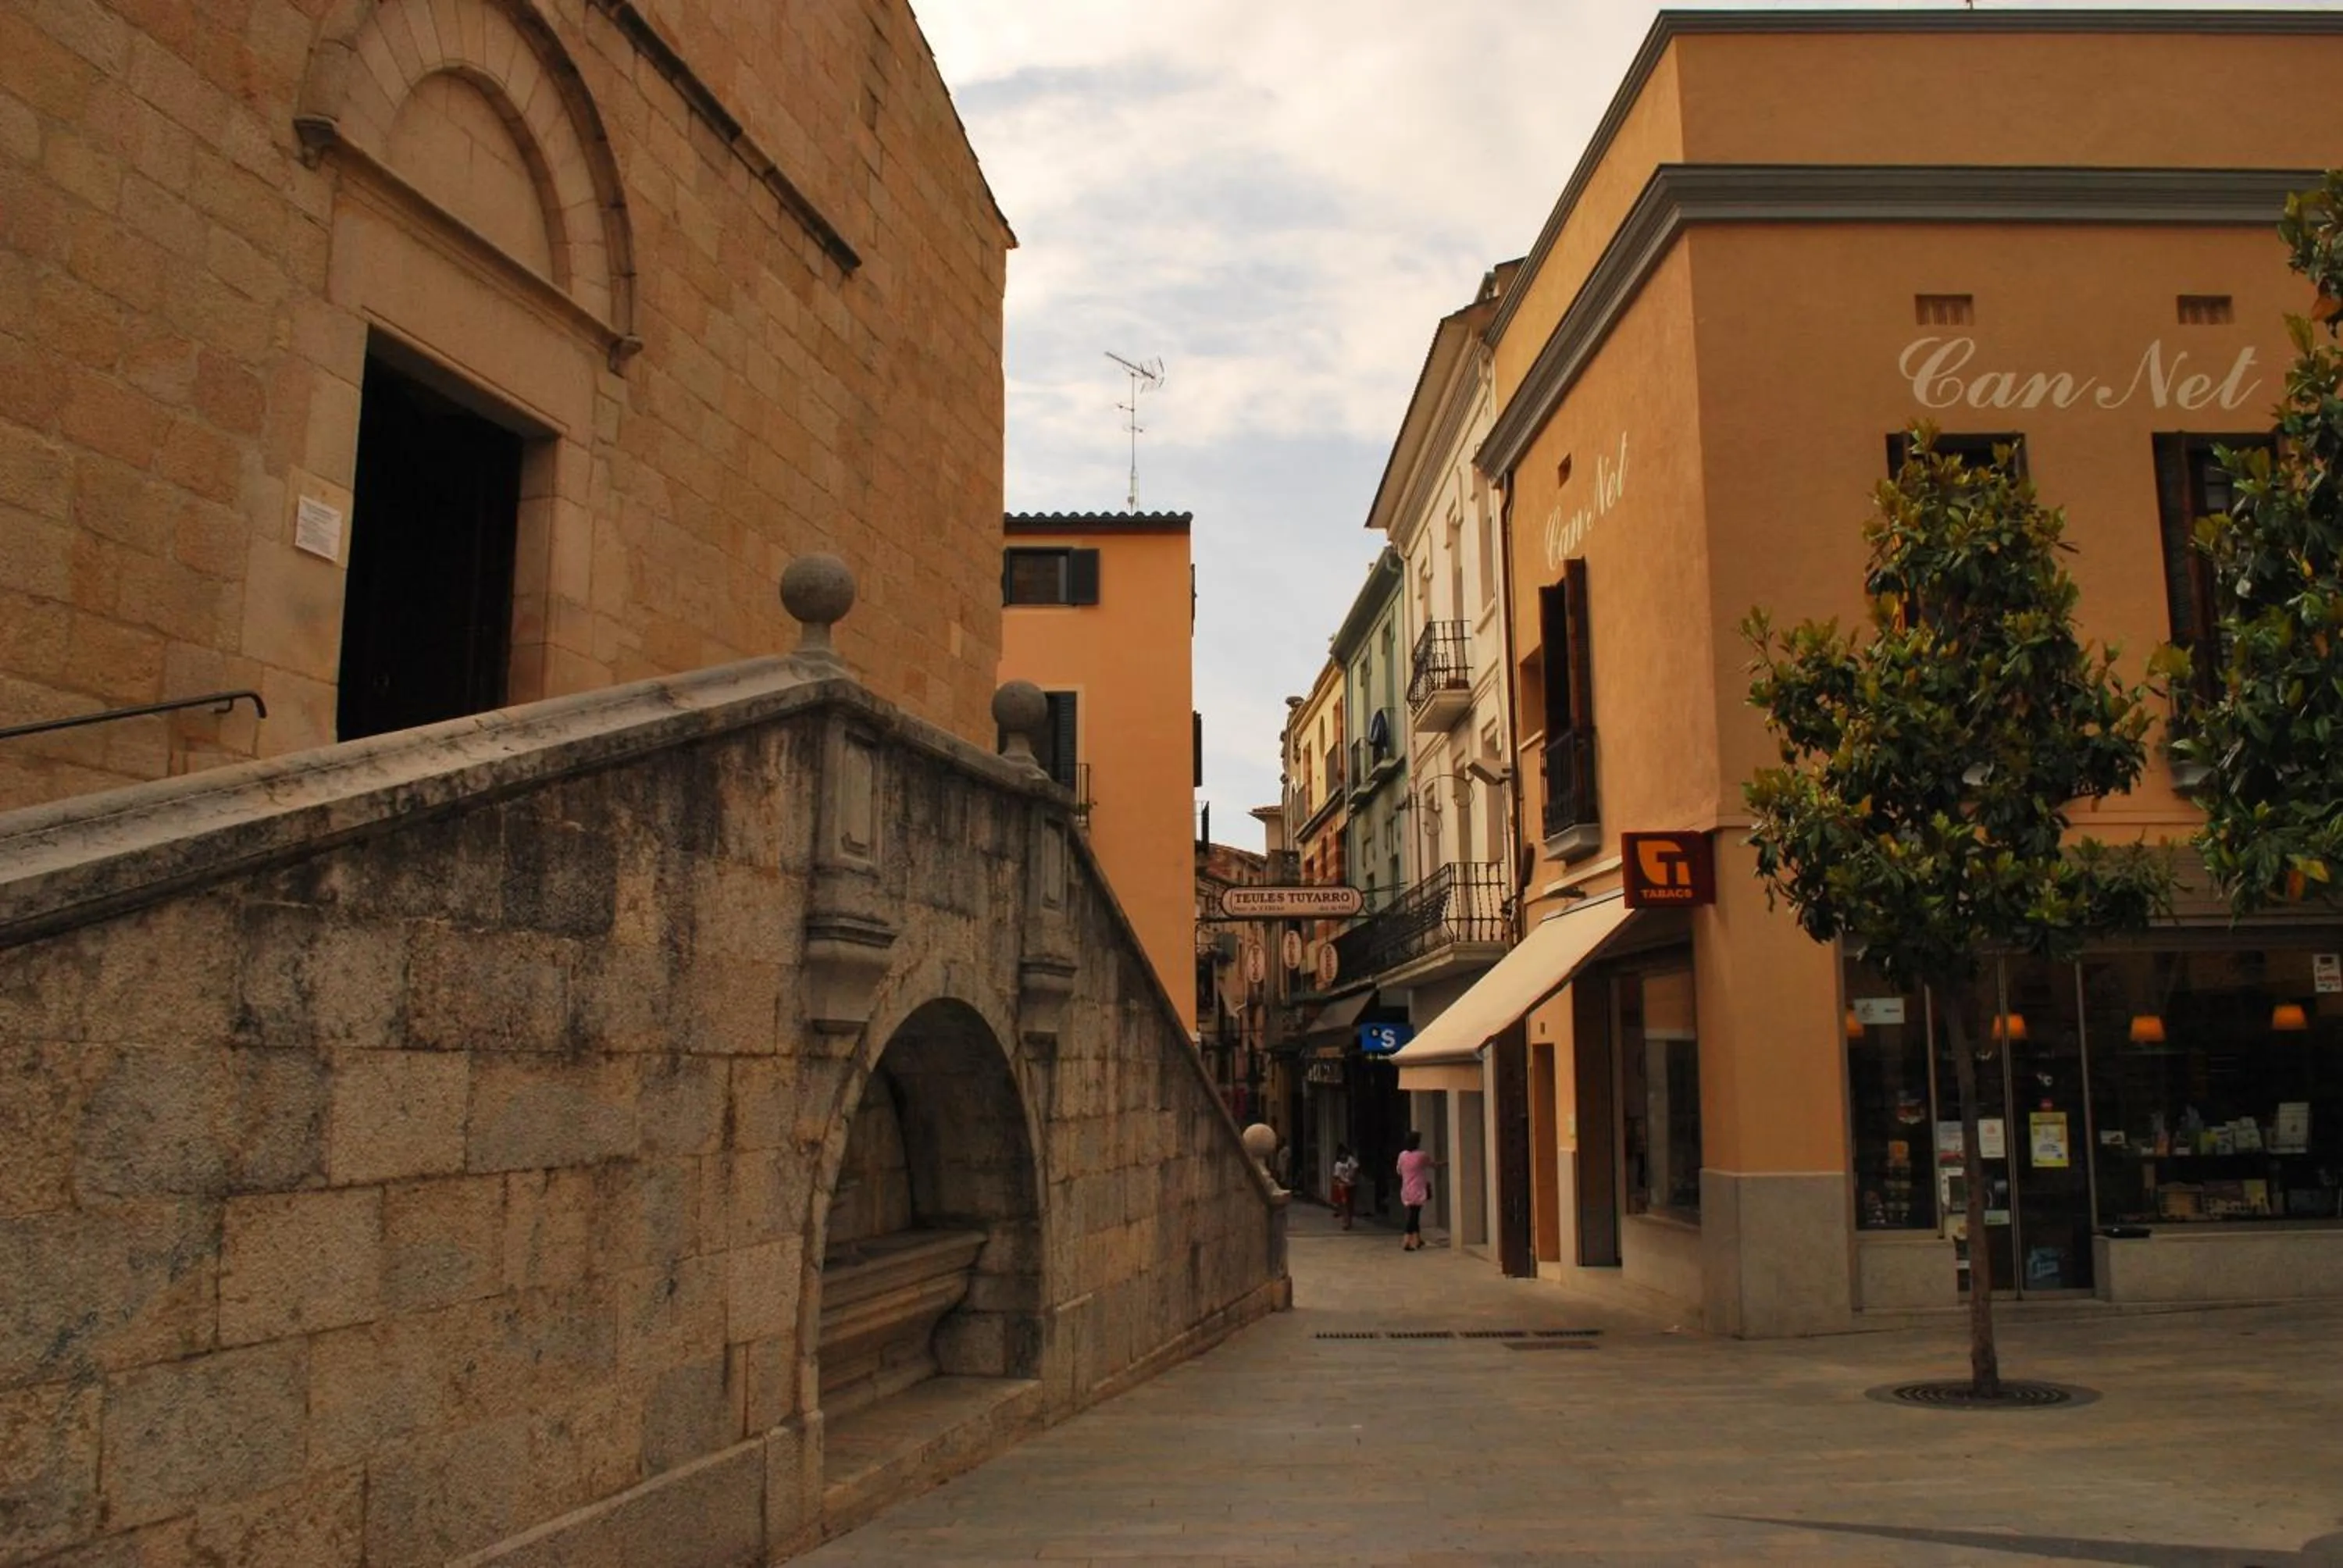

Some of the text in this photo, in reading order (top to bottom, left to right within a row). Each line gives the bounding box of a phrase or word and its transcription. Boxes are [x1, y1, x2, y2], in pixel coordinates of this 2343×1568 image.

[1899, 337, 2262, 410] Can Net
[1235, 893, 1285, 903] TEULES
[1641, 889, 1693, 899] TABACS
